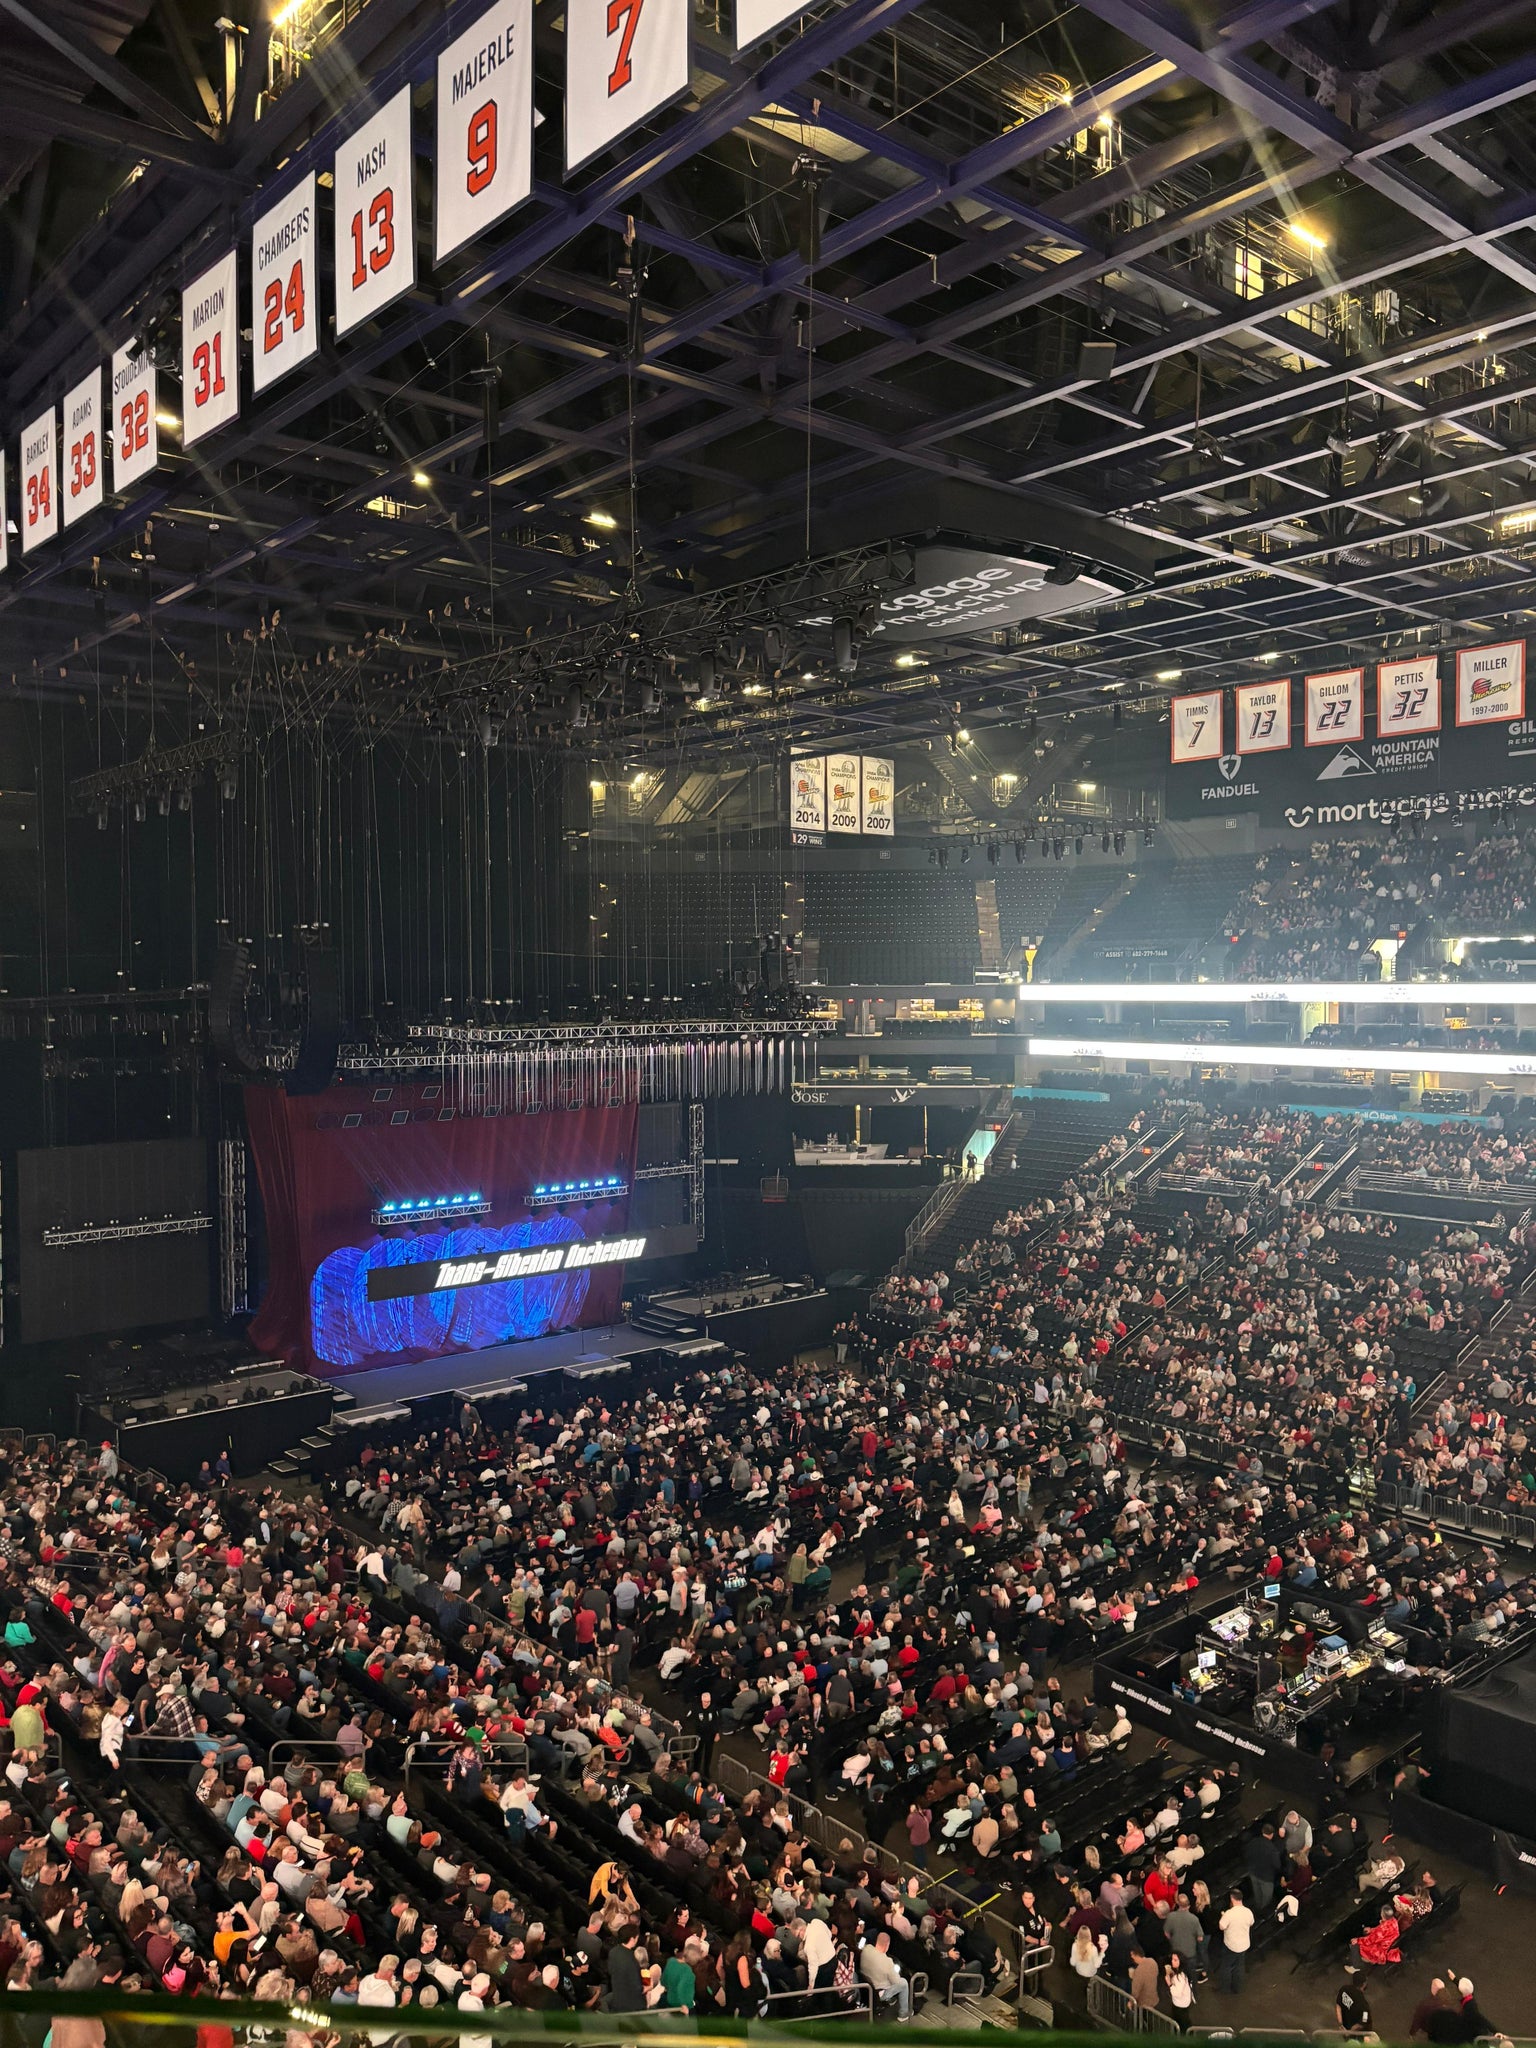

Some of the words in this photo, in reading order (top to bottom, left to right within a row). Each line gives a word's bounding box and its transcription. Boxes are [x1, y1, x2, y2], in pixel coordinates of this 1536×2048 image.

[607, 0, 644, 98] 7
[452, 24, 515, 105] MAJERLE
[466, 98, 498, 197] 9
[357, 139, 387, 188] NASH
[258, 207, 309, 271] CHAMBERS
[351, 186, 395, 291] 13
[193, 287, 225, 331] MARION
[264, 259, 305, 355] 24
[192, 331, 226, 408] 31
[72, 397, 92, 429] ADAMS
[121, 389, 149, 462] 32
[26, 431, 49, 465] BARKLEY
[71, 431, 96, 497] 33
[27, 465, 50, 526] 34
[885, 577, 1048, 625] matchup
[927, 603, 1010, 627] center
[1394, 672, 1424, 686] PETTIS
[1473, 657, 1507, 673] MILLER
[1250, 694, 1276, 707] TAYLOR
[1319, 684, 1349, 697] GILLOM
[1389, 688, 1428, 721] 32
[1186, 705, 1209, 717] TIMMS
[1316, 700, 1351, 731] 22
[1471, 702, 1509, 715] 1997-2000
[1188, 720, 1206, 748] 7
[1249, 710, 1277, 739] 13
[1371, 736, 1440, 756] MOUNTAIN
[1375, 750, 1434, 767] AMERICA
[1201, 783, 1260, 800] FANDUEL
[795, 811, 820, 824] 2014
[832, 814, 857, 827] 2009
[866, 817, 891, 829] 2007
[797, 833, 808, 845] 29
[791, 1091, 827, 1103] OOSE
[563, 1238, 646, 1268] Orchestra
